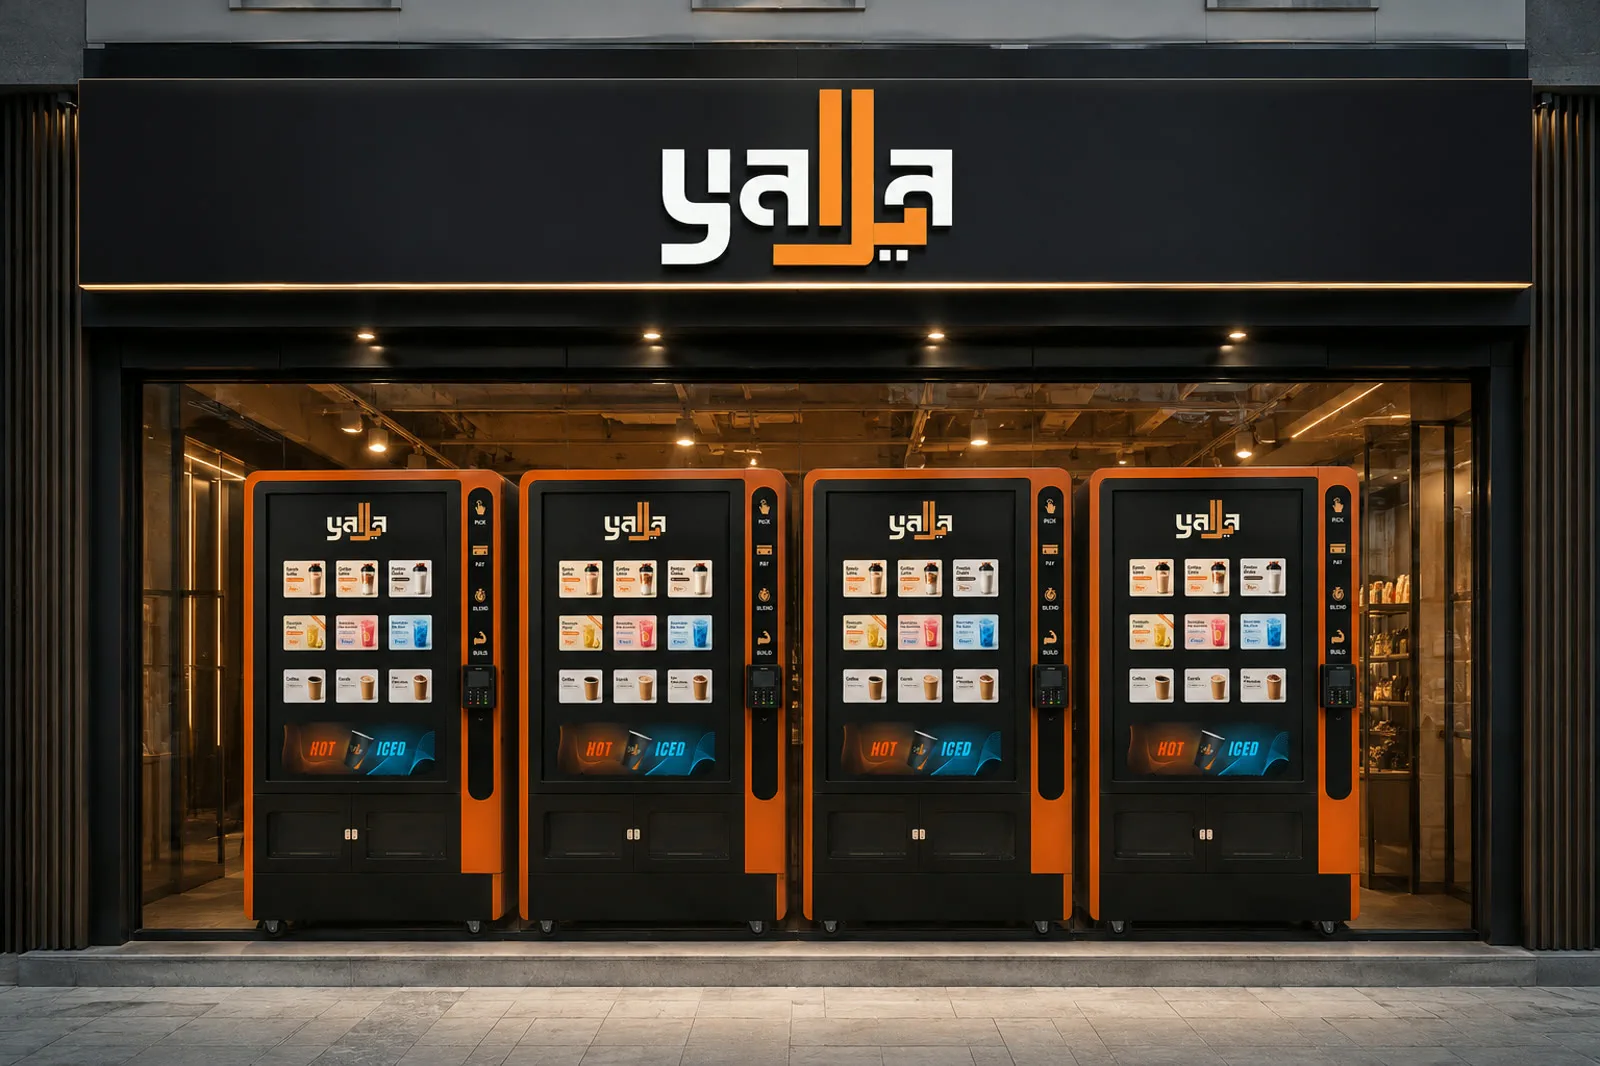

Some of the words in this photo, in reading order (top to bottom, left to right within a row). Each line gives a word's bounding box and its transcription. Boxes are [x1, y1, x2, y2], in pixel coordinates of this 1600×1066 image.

[661, 89, 952, 265] yalla
[327, 503, 386, 540] yalla
[605, 502, 666, 540] yalla
[890, 501, 952, 540] yalla
[1176, 500, 1239, 539] yalla
[310, 741, 336, 756] HOT
[377, 741, 405, 756] ICED
[586, 742, 612, 756] HOT
[656, 742, 685, 756] ICED
[871, 741, 897, 756] HOT
[942, 741, 971, 756] ICED
[1158, 741, 1184, 756] HOT
[1229, 741, 1258, 756] ICED
